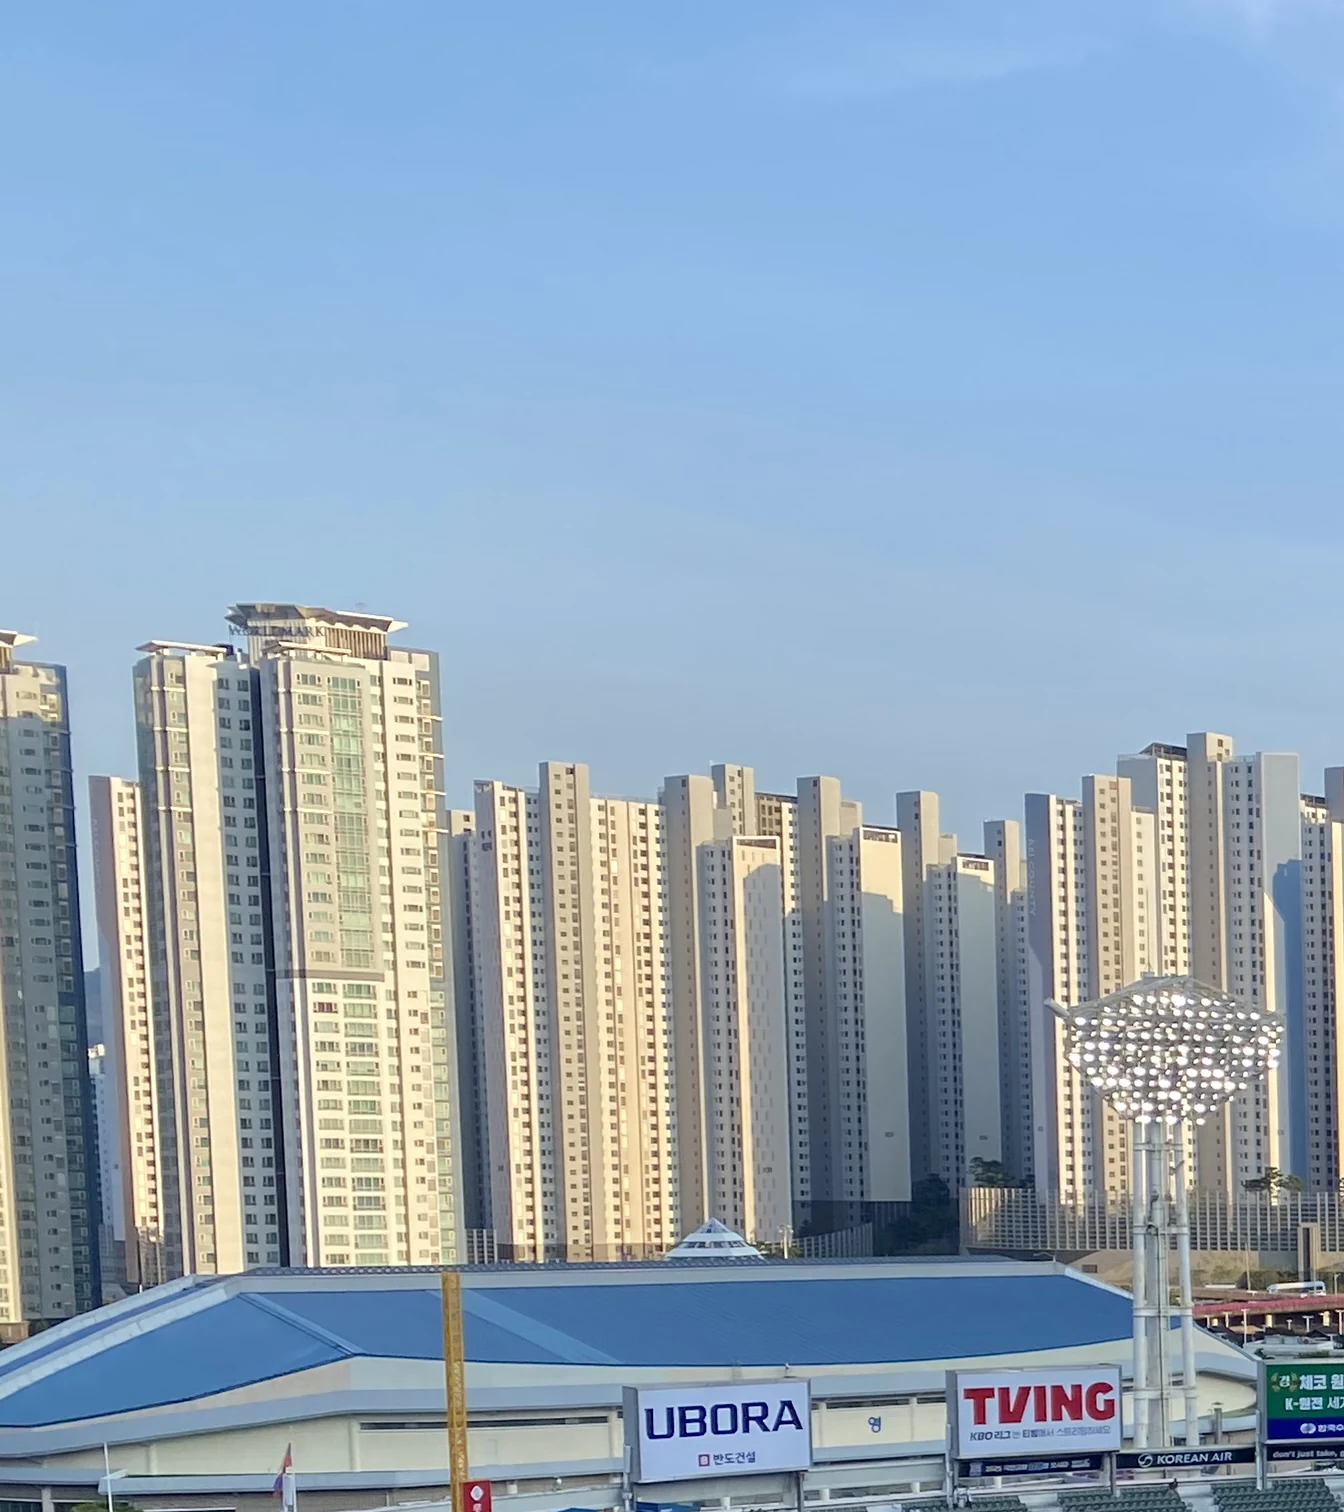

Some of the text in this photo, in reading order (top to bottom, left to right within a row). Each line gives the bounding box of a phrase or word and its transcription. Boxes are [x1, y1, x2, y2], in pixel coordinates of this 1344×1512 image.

[1300, 1374, 1327, 1390] 체코
[963, 1382, 1115, 1425] TVING
[644, 1400, 803, 1440] UBORA
[970, 1431, 993, 1441] KBO
[713, 1451, 756, 1465] 반도건설
[1157, 1451, 1232, 1465] KOREAN AIR
